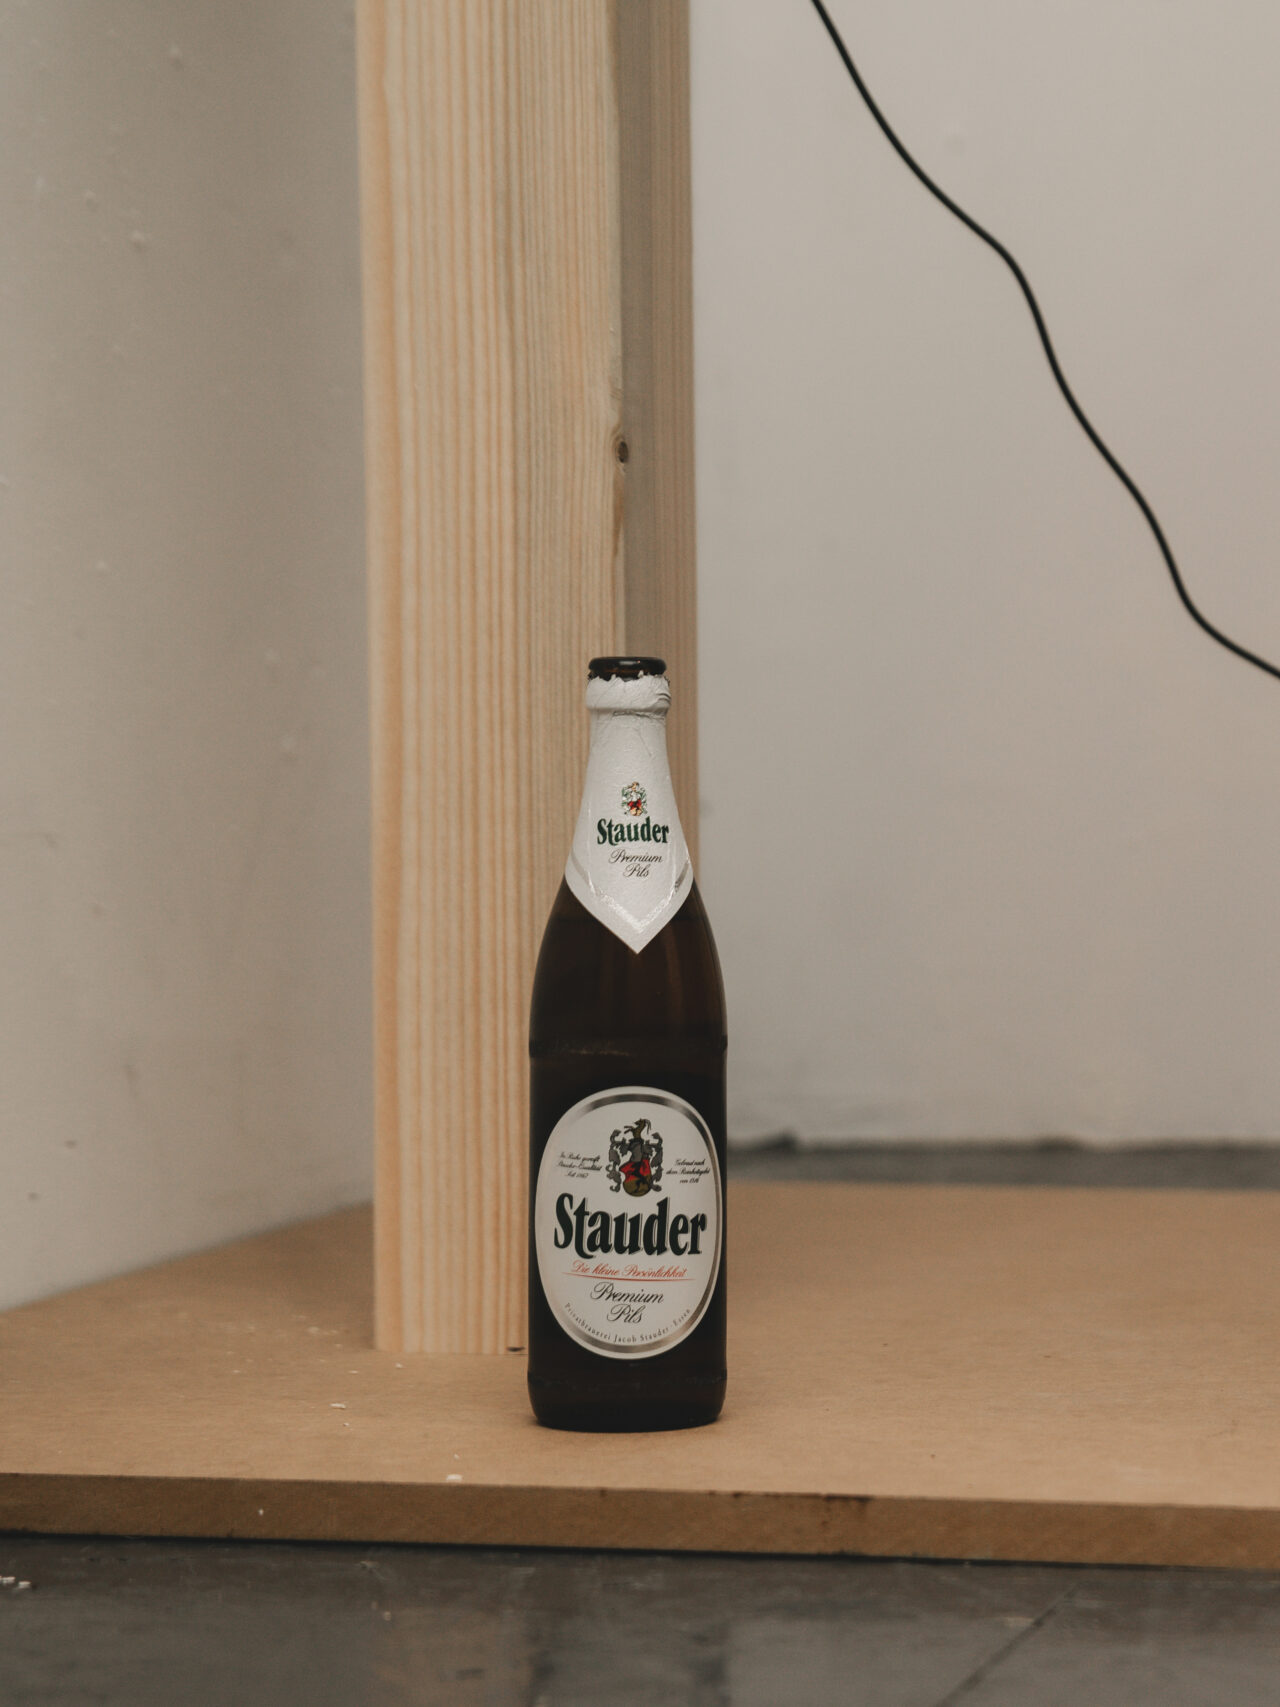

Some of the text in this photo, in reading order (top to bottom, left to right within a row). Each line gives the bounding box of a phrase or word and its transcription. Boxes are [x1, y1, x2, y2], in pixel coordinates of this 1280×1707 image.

[597, 816, 669, 846] Stauder
[608, 848, 663, 864] Premium
[623, 863, 650, 878] Pils
[553, 1192, 708, 1259] Stauder
[592, 1261, 619, 1276] kleine
[590, 1281, 665, 1304] Premium
[606, 1303, 647, 1324] Pils
